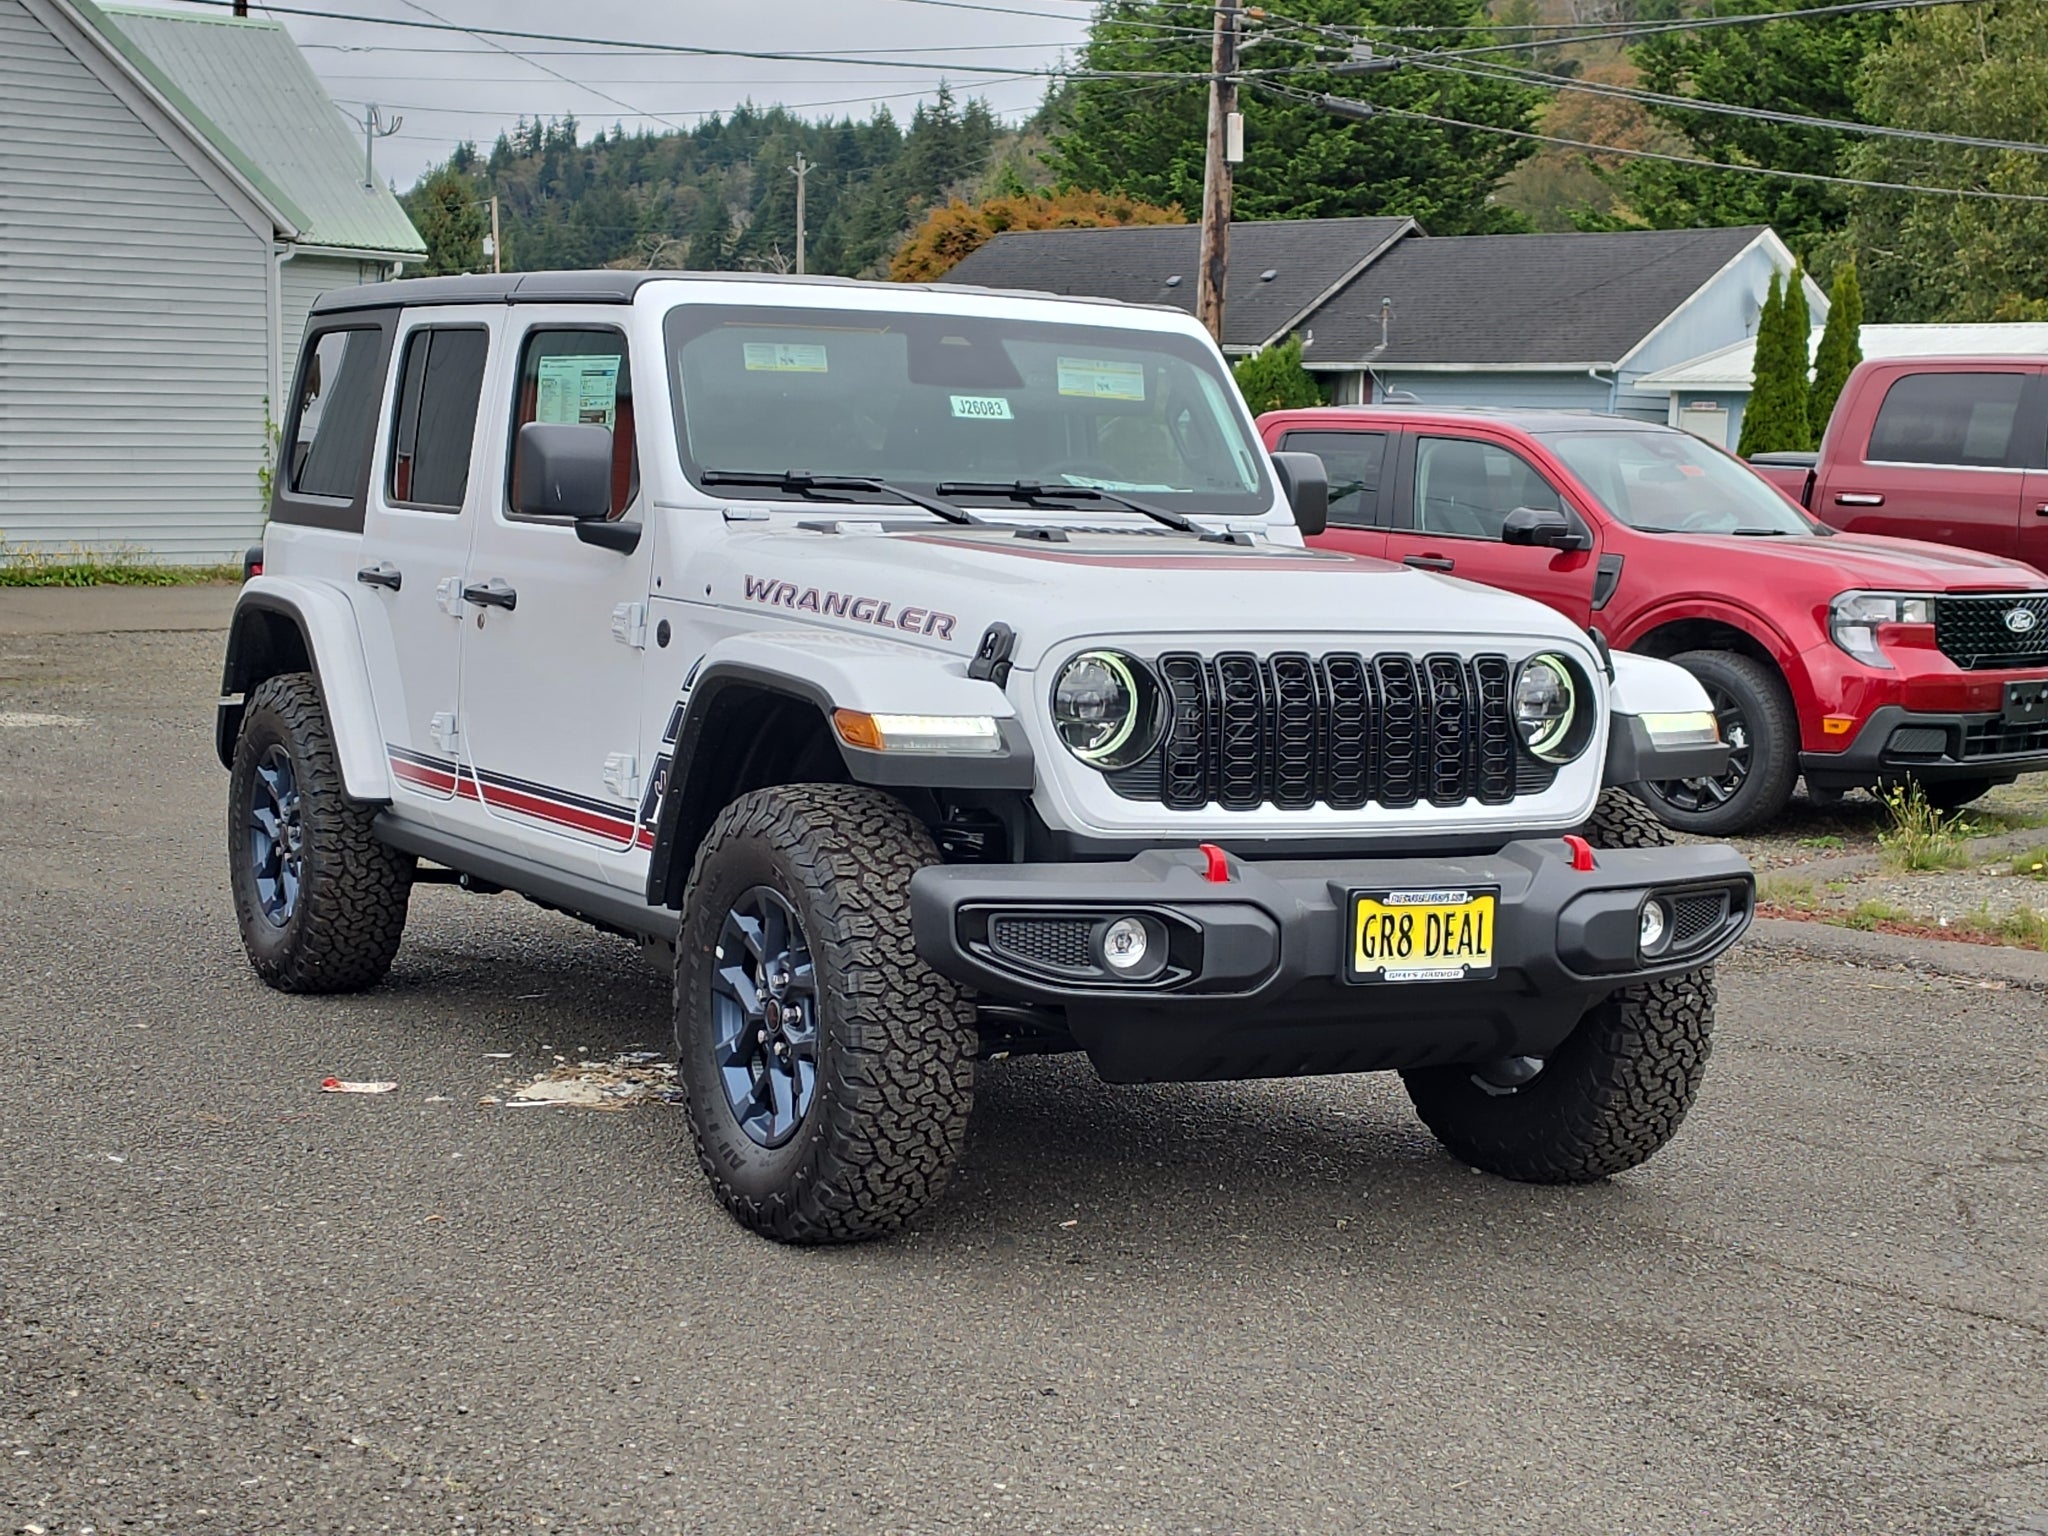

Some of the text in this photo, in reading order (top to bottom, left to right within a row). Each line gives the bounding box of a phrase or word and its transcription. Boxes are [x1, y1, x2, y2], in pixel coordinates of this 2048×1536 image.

[959, 399, 1003, 416] J26083
[744, 574, 957, 641] WRANGLER
[1362, 911, 1488, 960] GR8 DEAL
